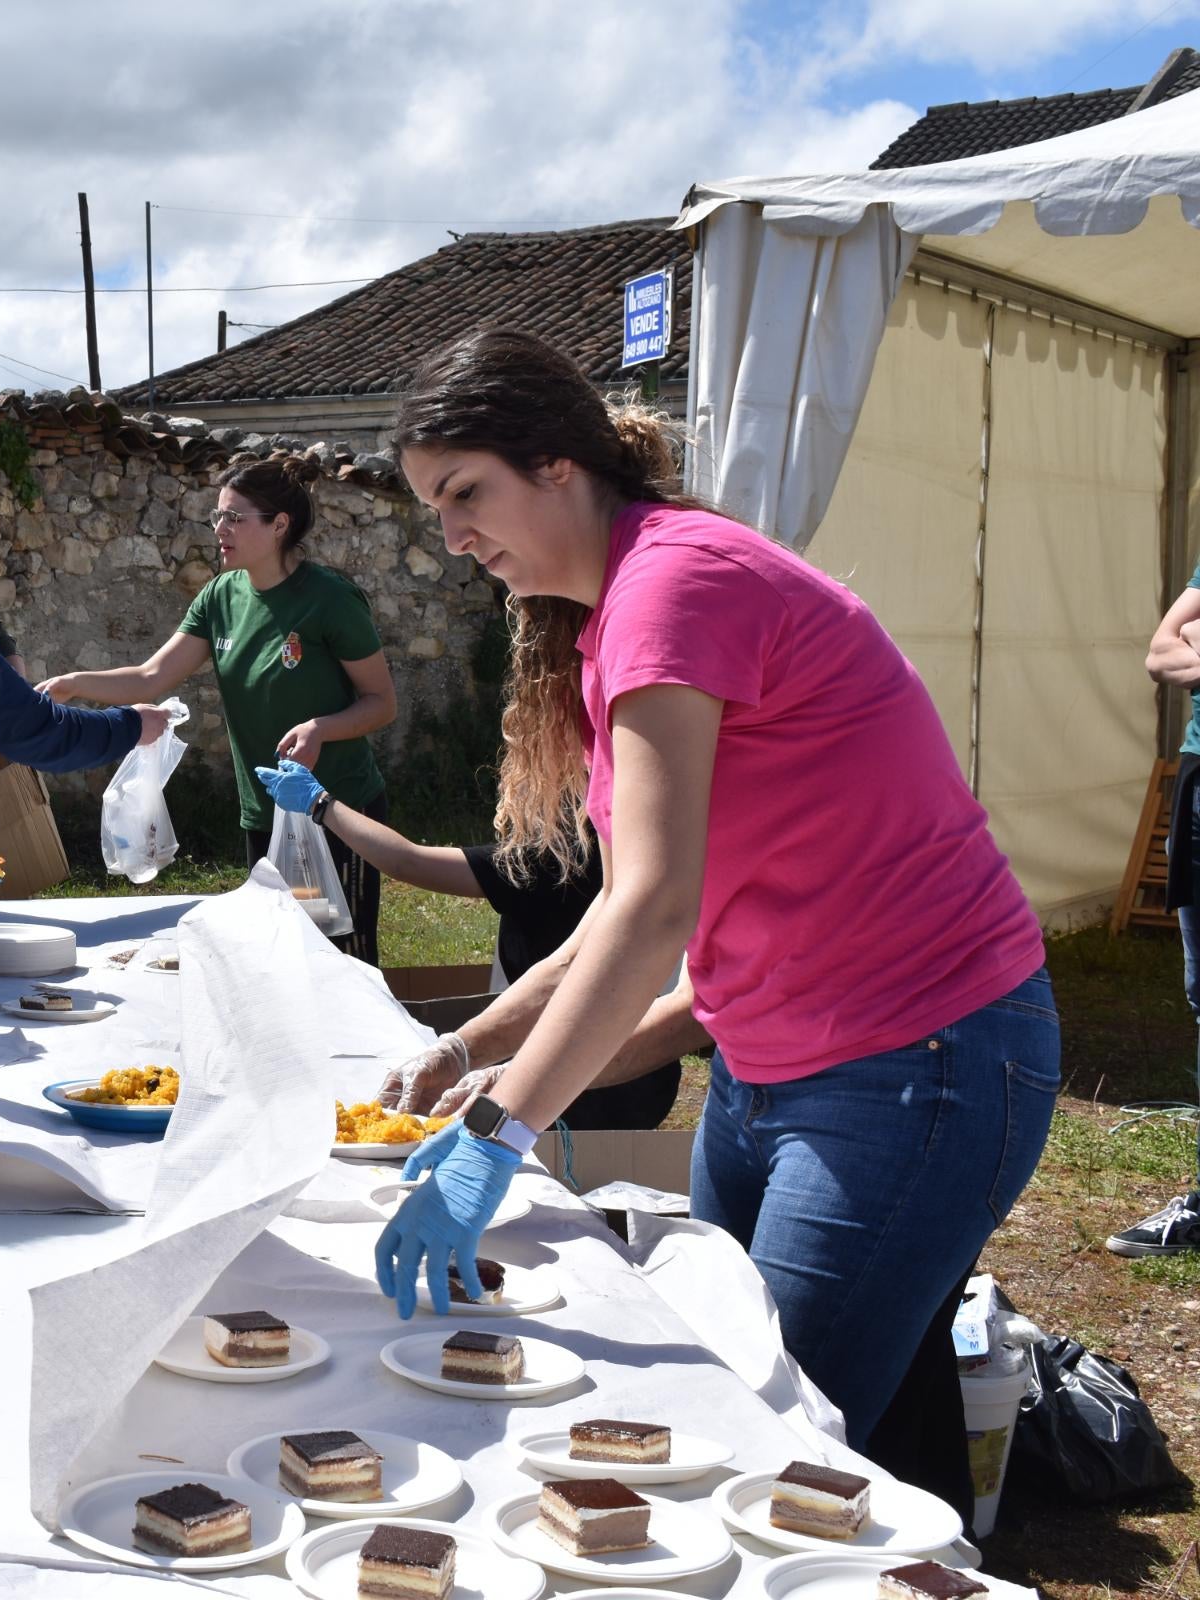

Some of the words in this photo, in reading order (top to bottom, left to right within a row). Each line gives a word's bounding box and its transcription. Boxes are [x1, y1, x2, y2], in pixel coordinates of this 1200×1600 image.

[636, 283, 662, 299] INMUEBLES
[630, 310, 659, 337] VENDE
[626, 342, 636, 360] 649
[636, 338, 647, 356] 900
[648, 335, 663, 353] 447
[969, 1340, 979, 1350] M
